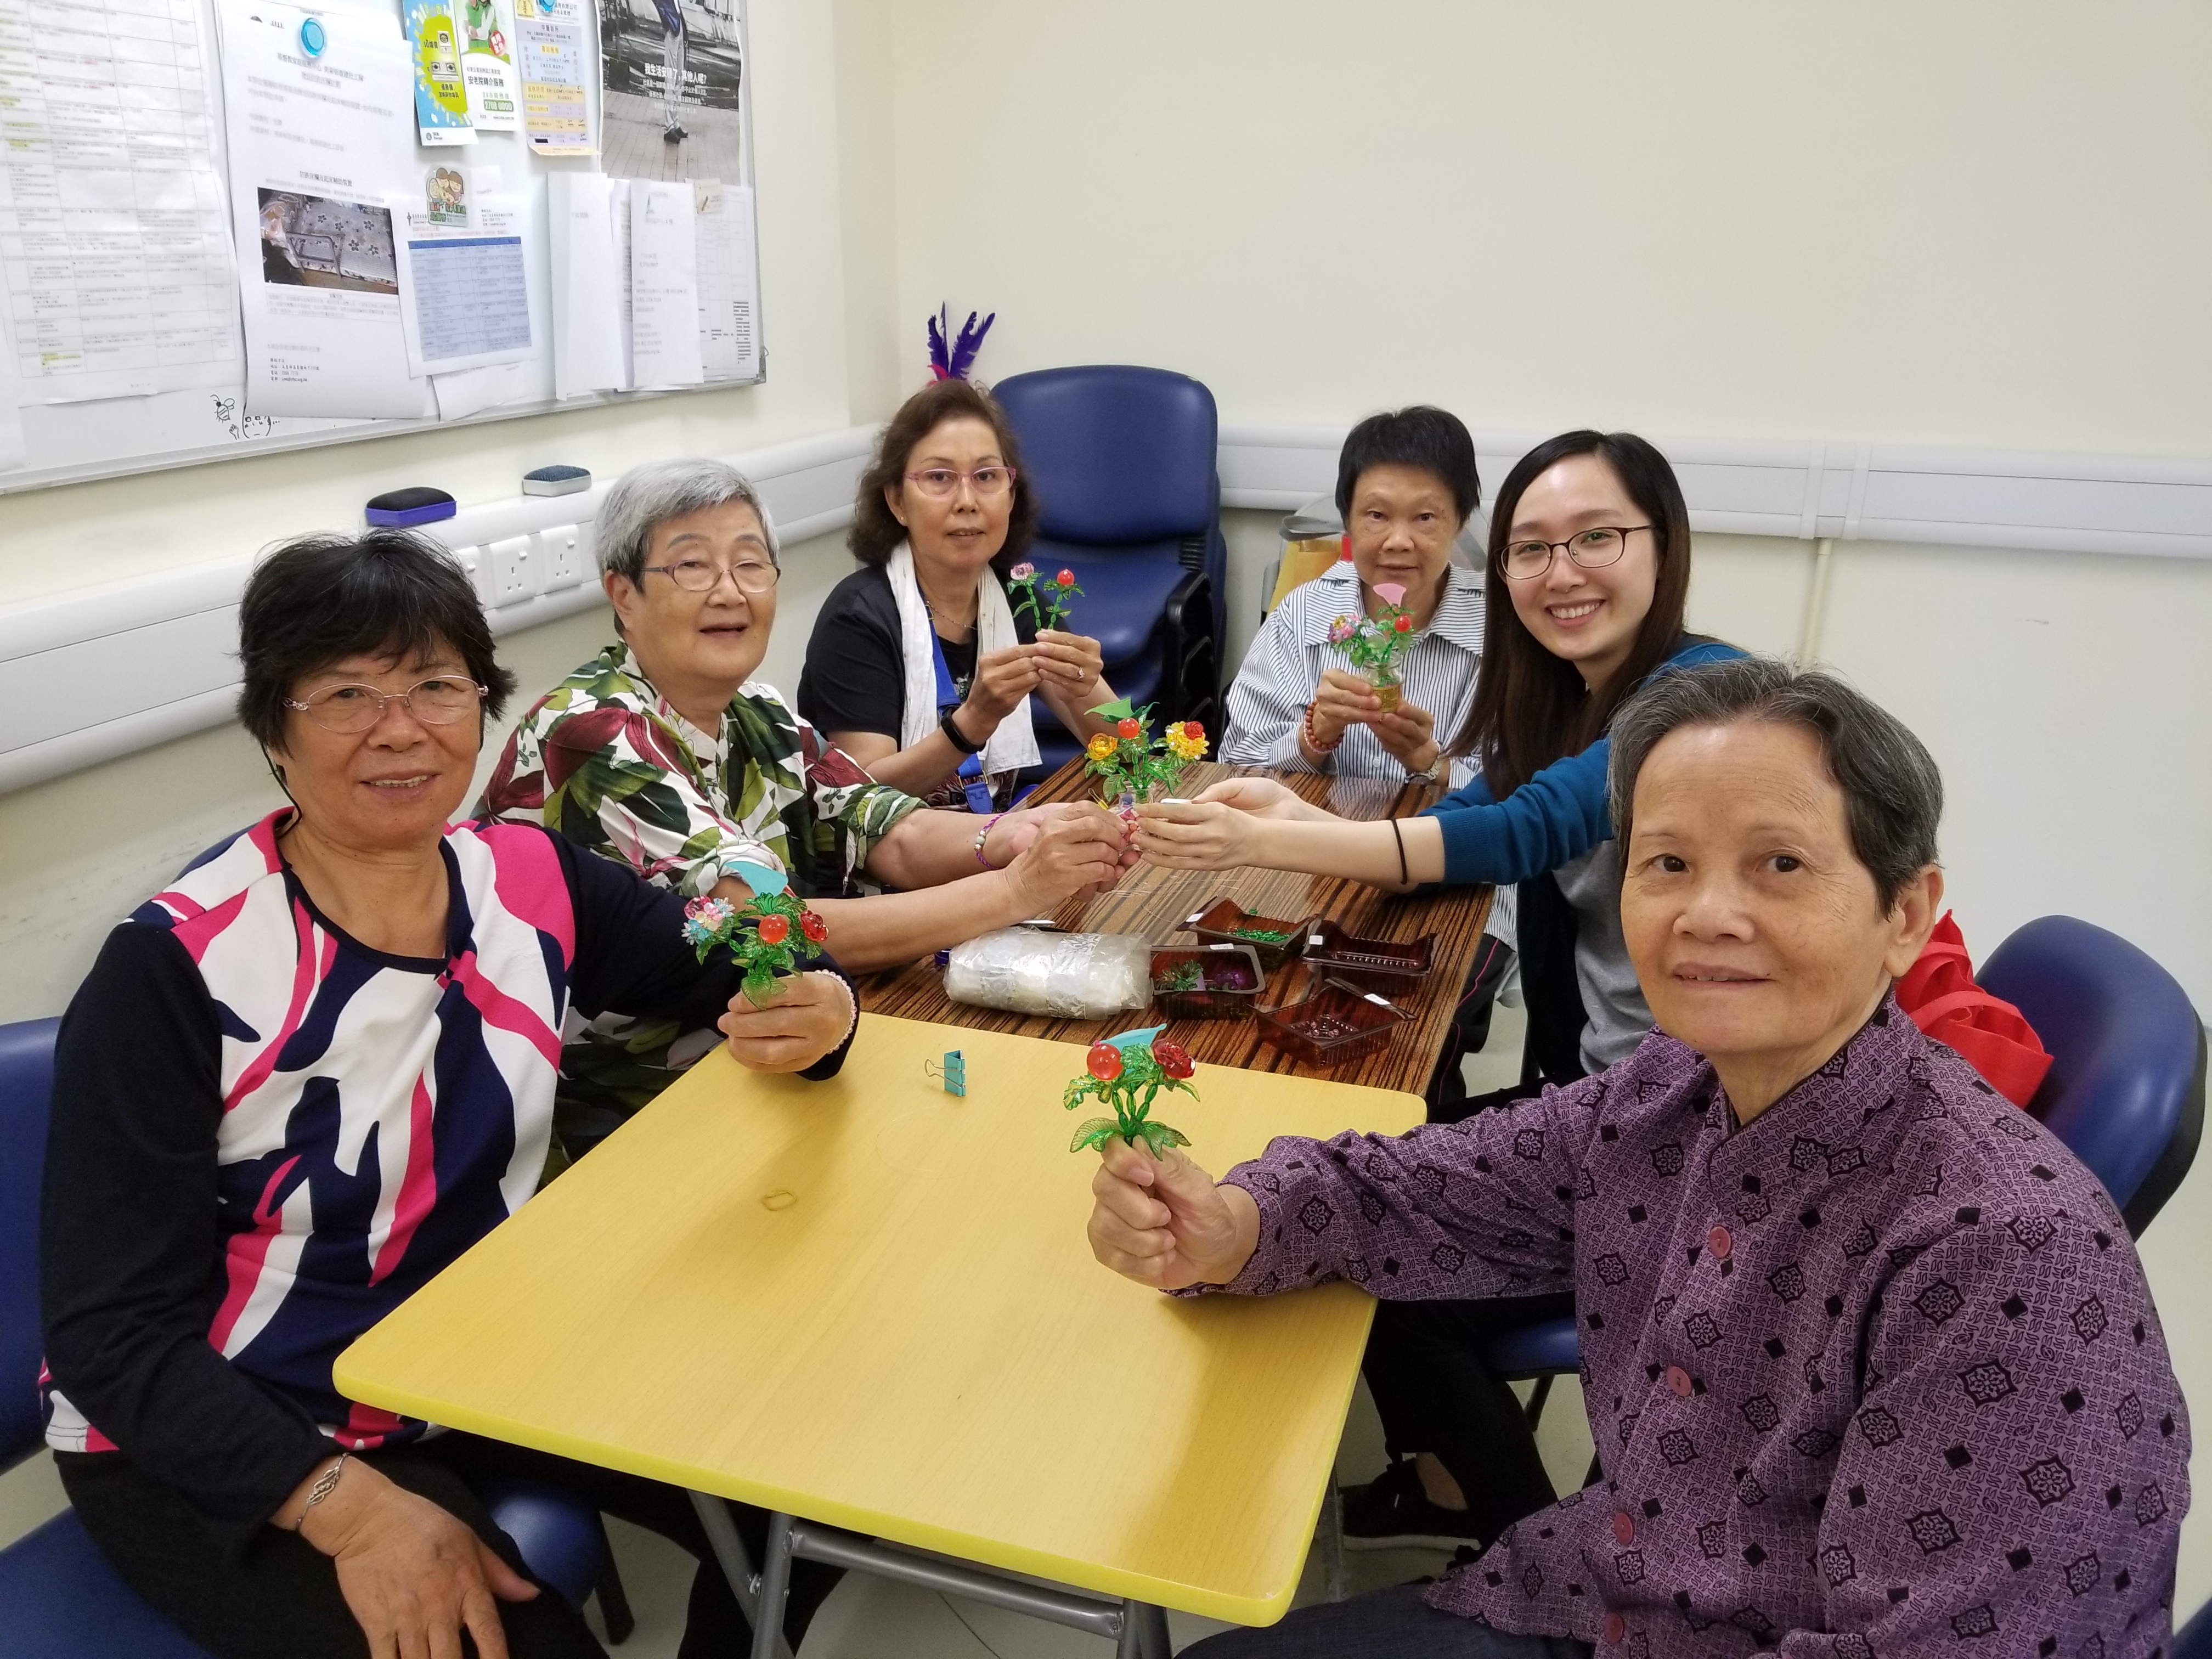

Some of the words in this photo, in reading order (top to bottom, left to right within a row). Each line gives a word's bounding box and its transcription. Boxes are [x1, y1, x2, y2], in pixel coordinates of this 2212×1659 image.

[467, 76, 504, 87] 安老院轉介服務
